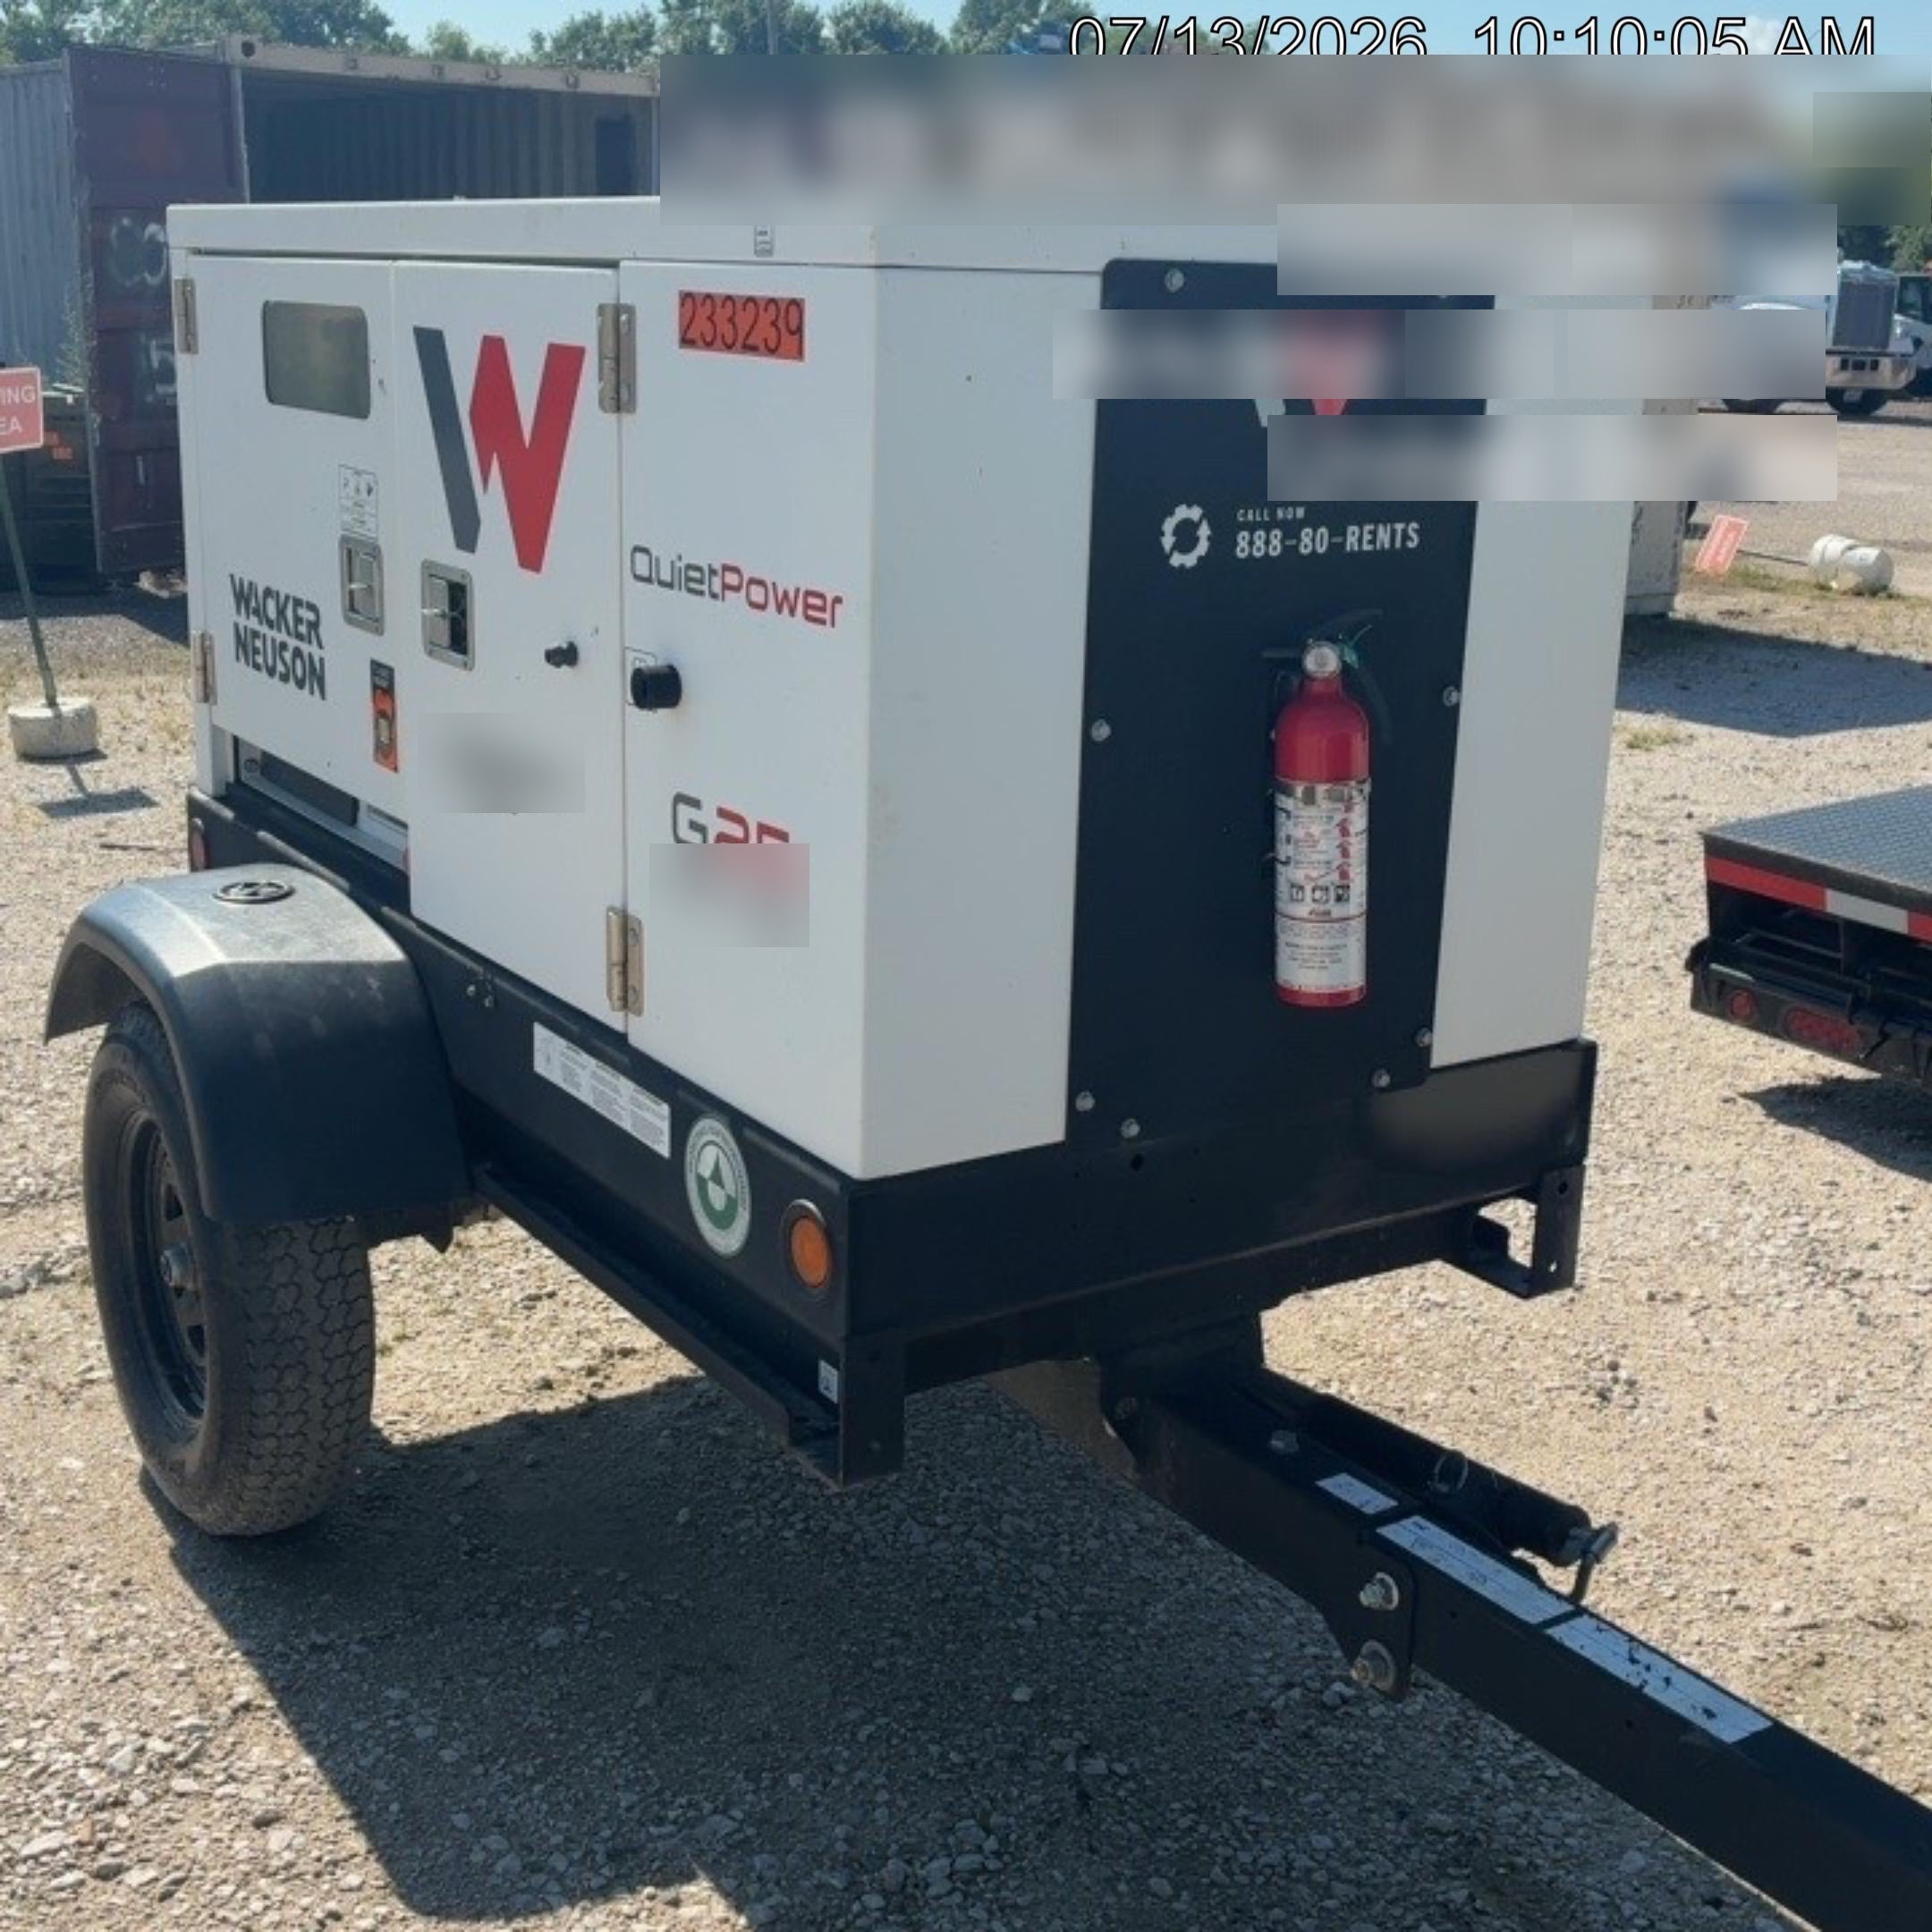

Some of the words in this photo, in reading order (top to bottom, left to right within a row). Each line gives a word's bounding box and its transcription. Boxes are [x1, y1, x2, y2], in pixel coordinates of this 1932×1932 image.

[681, 292, 803, 360] 233239
[1236, 521, 1420, 559] 888-80-RENTS
[1237, 509, 1270, 521] CALL
[1276, 506, 1305, 521] NOW
[229, 573, 325, 650] WACKER
[631, 545, 843, 628] QuietPower
[233, 621, 326, 701] NEUSON
